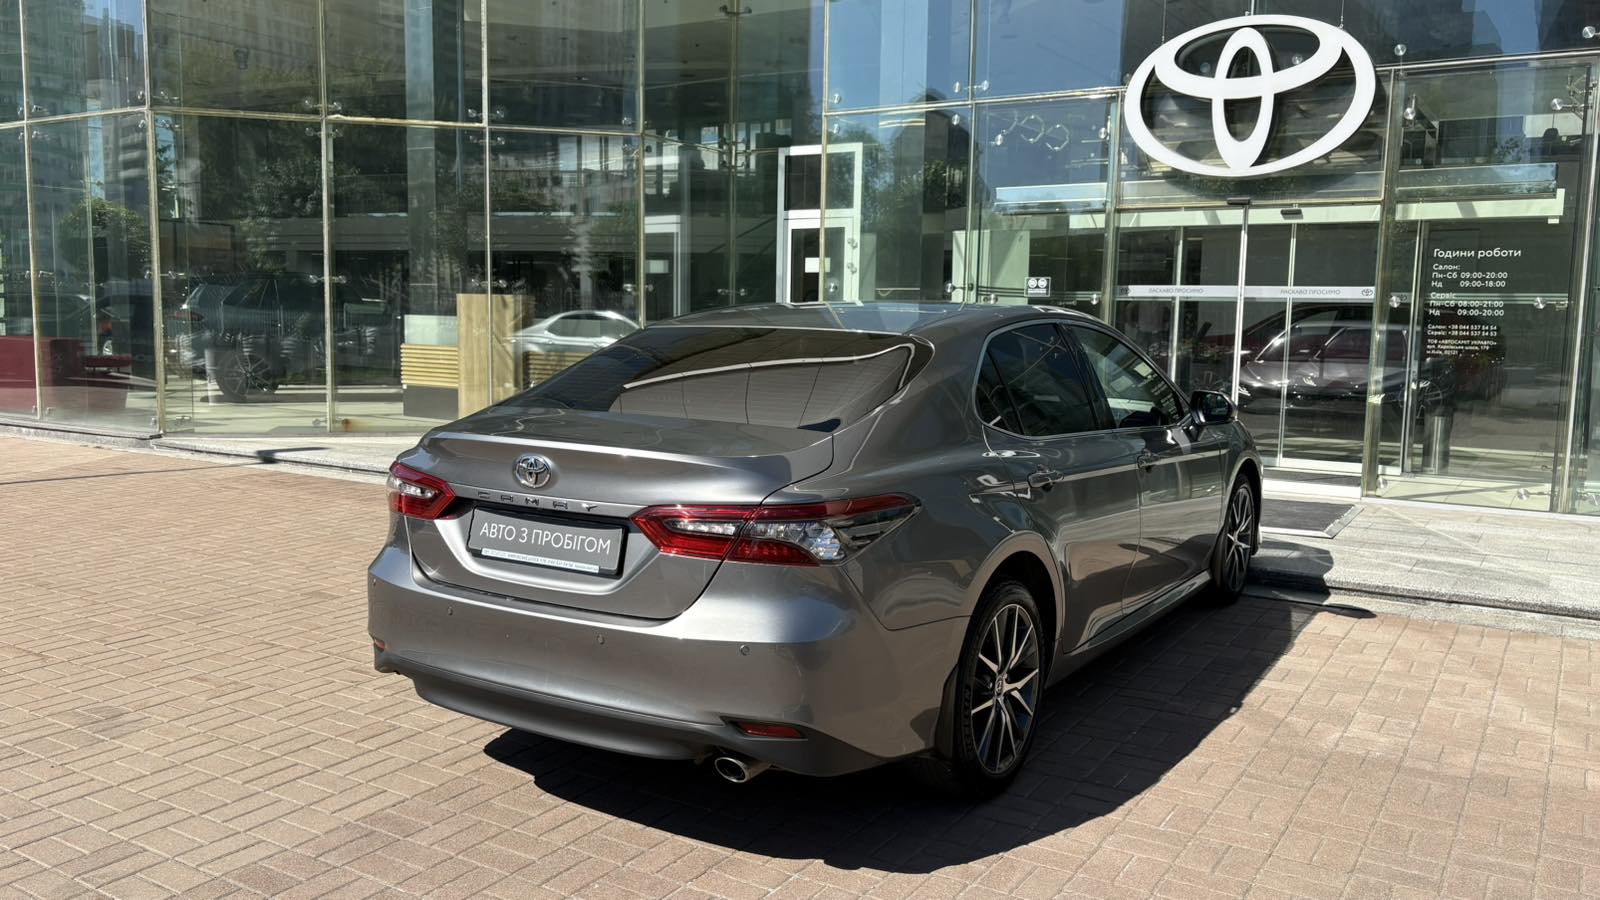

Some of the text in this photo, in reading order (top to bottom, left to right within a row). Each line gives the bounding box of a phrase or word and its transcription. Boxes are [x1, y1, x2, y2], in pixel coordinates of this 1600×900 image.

[1433, 247, 1522, 259] Години роботи
[1431, 280, 1443, 288] Нд
[477, 490, 598, 513] CAMRY
[479, 522, 516, 542] АВТО
[531, 528, 611, 555] ПРОБІГОМ
